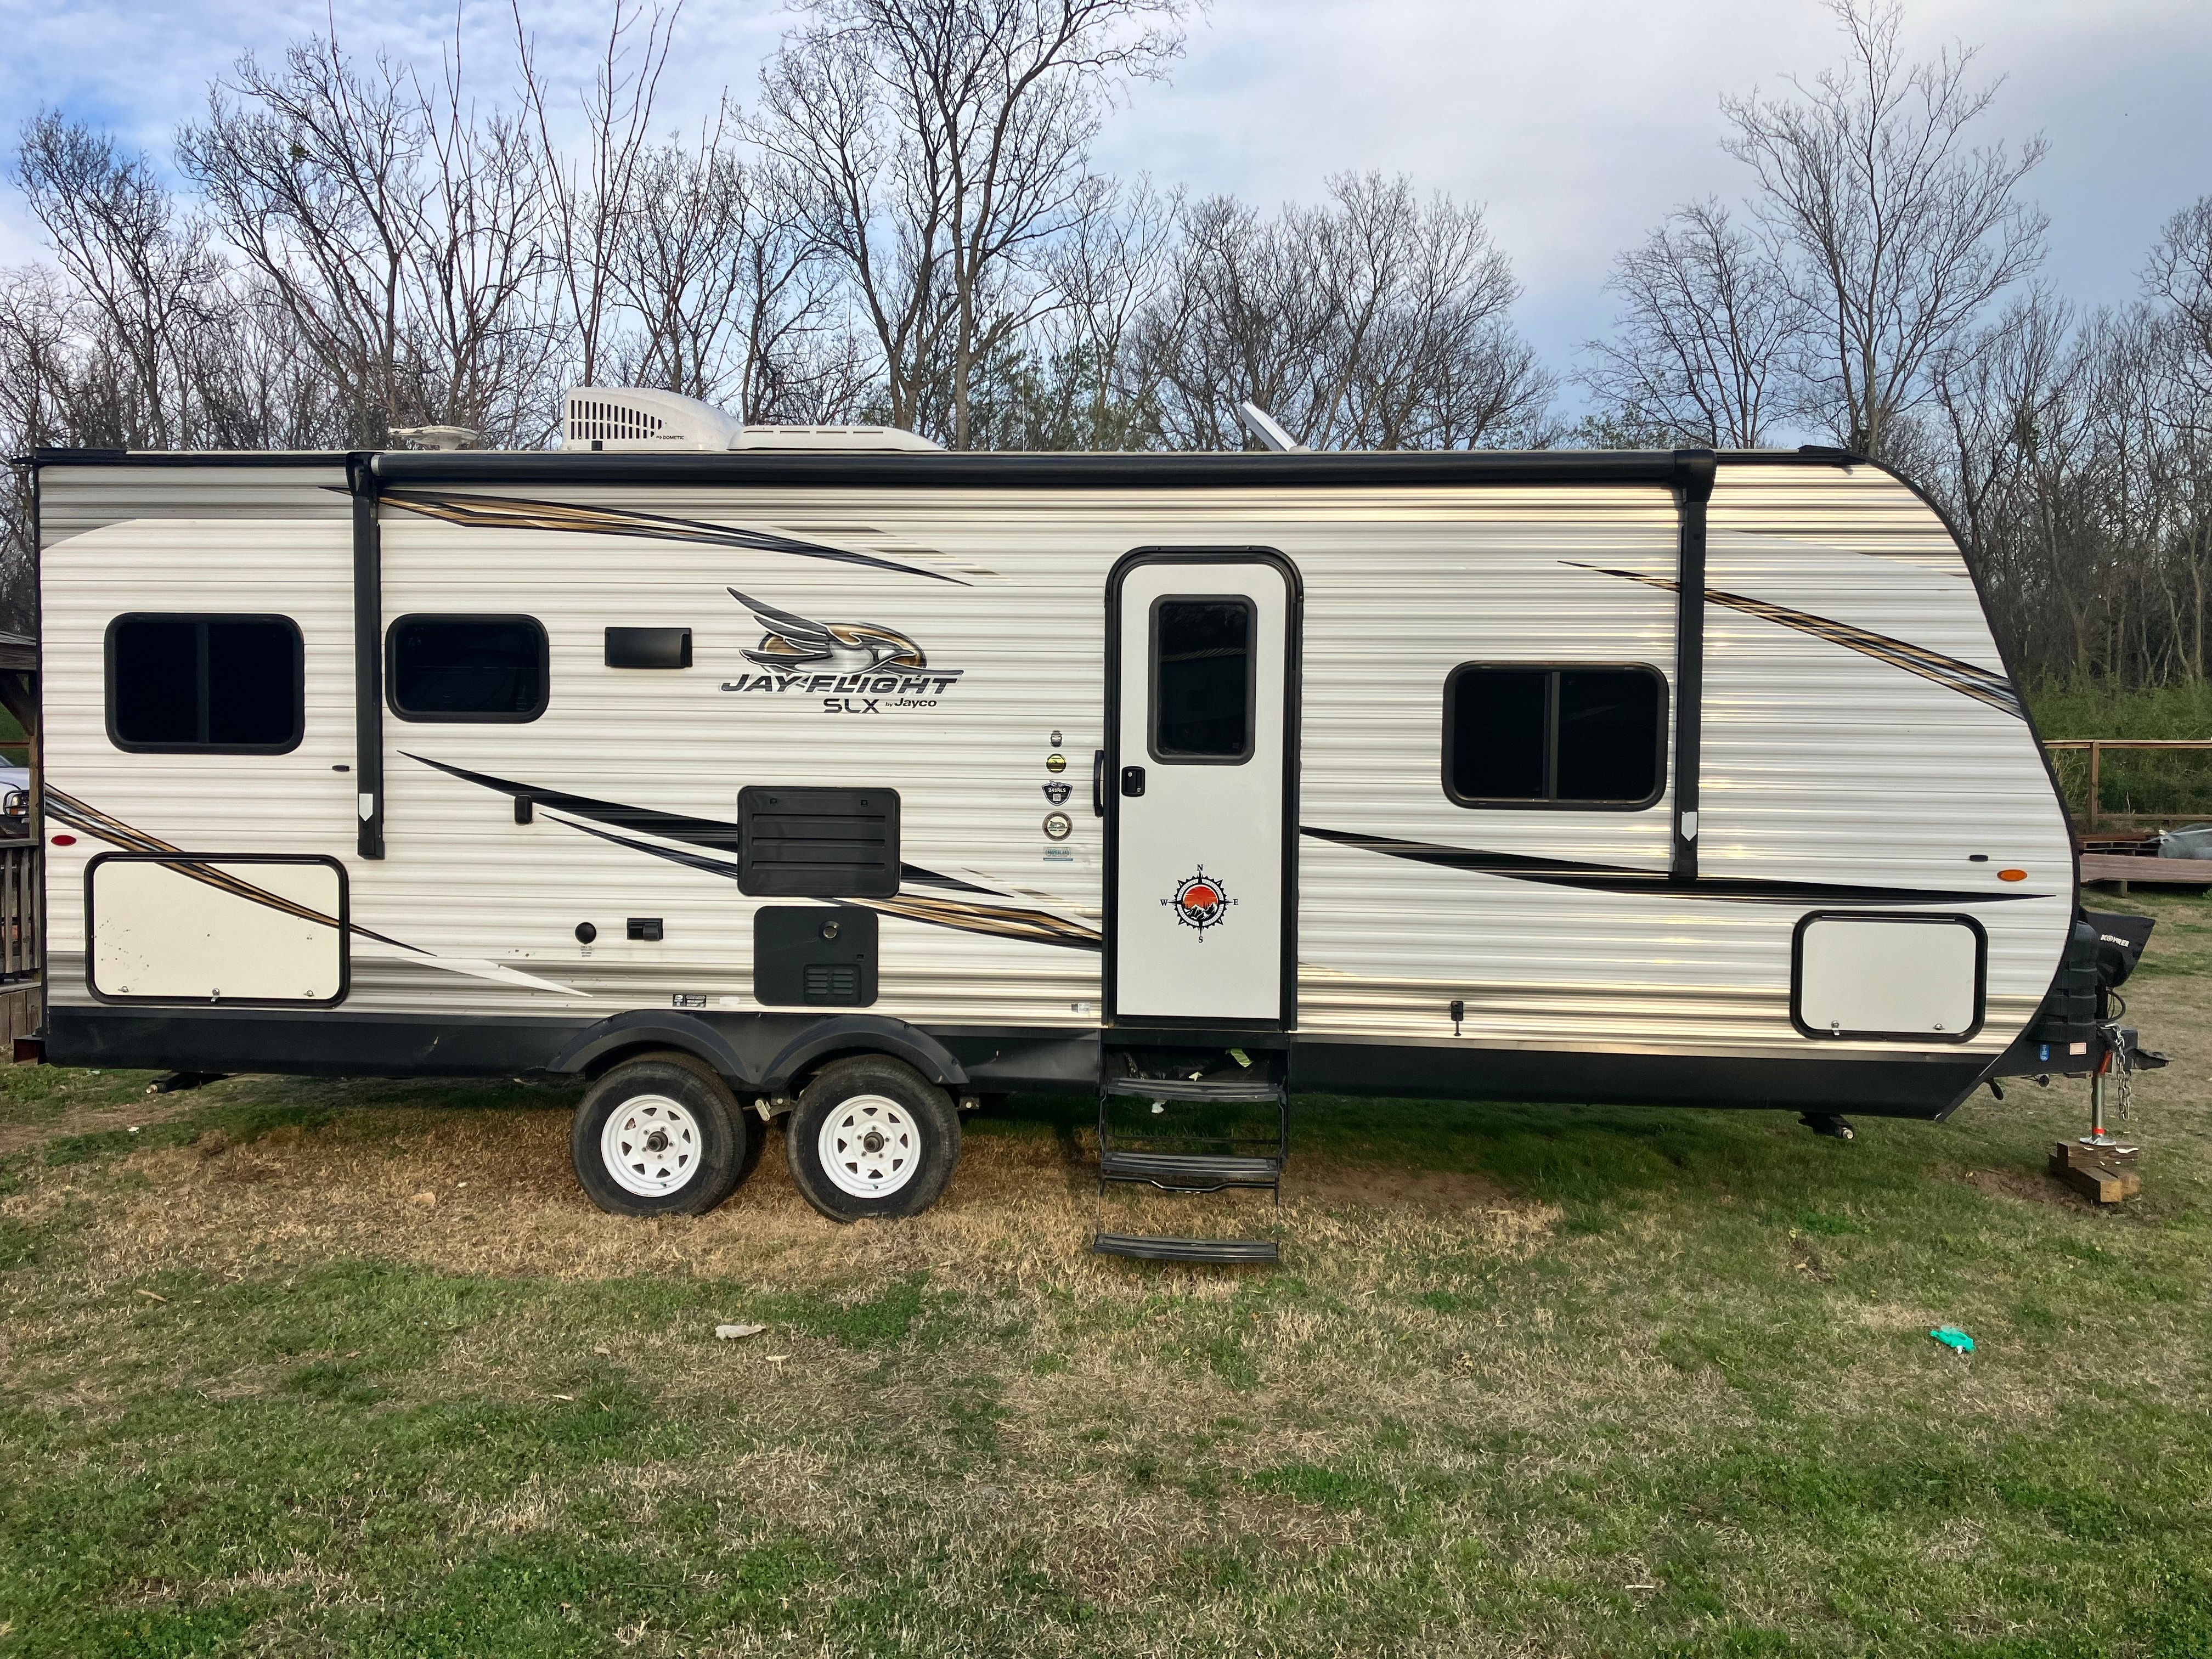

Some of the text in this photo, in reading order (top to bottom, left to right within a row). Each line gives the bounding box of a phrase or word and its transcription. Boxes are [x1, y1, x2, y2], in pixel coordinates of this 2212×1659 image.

[721, 674, 957, 694] JAY FLIGHT
[823, 698, 881, 713] SLX
[894, 698, 937, 708] Jayco
[2100, 934, 2130, 947] KOHREE
